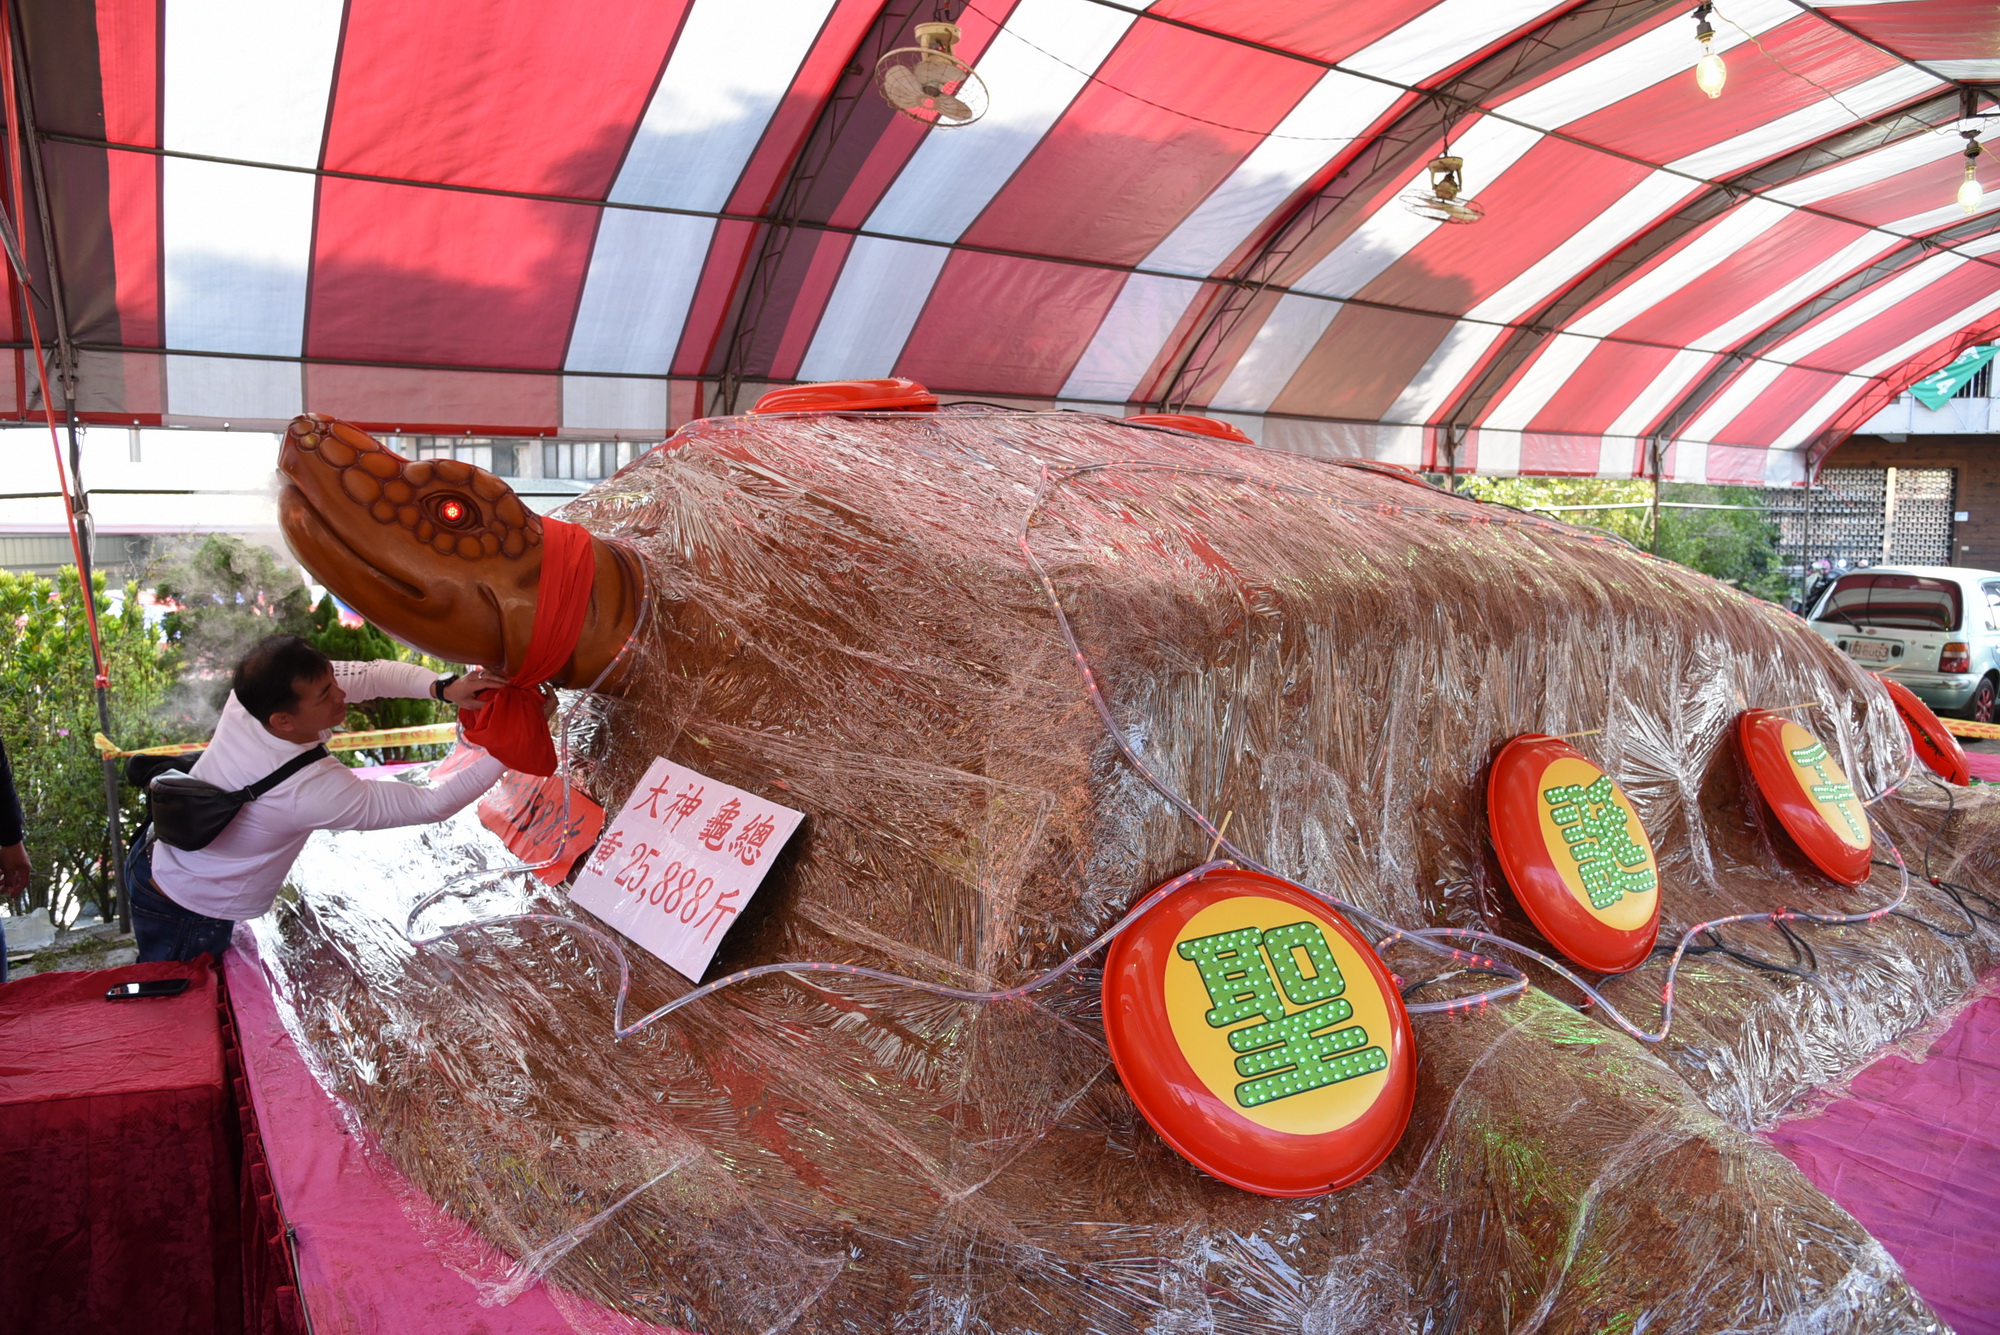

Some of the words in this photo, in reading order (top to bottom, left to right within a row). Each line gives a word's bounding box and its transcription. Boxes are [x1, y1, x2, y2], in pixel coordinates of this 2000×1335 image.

[1543, 775, 1658, 910] 誕
[1790, 742, 1864, 842] 千
[1176, 920, 1389, 1109] 聖
